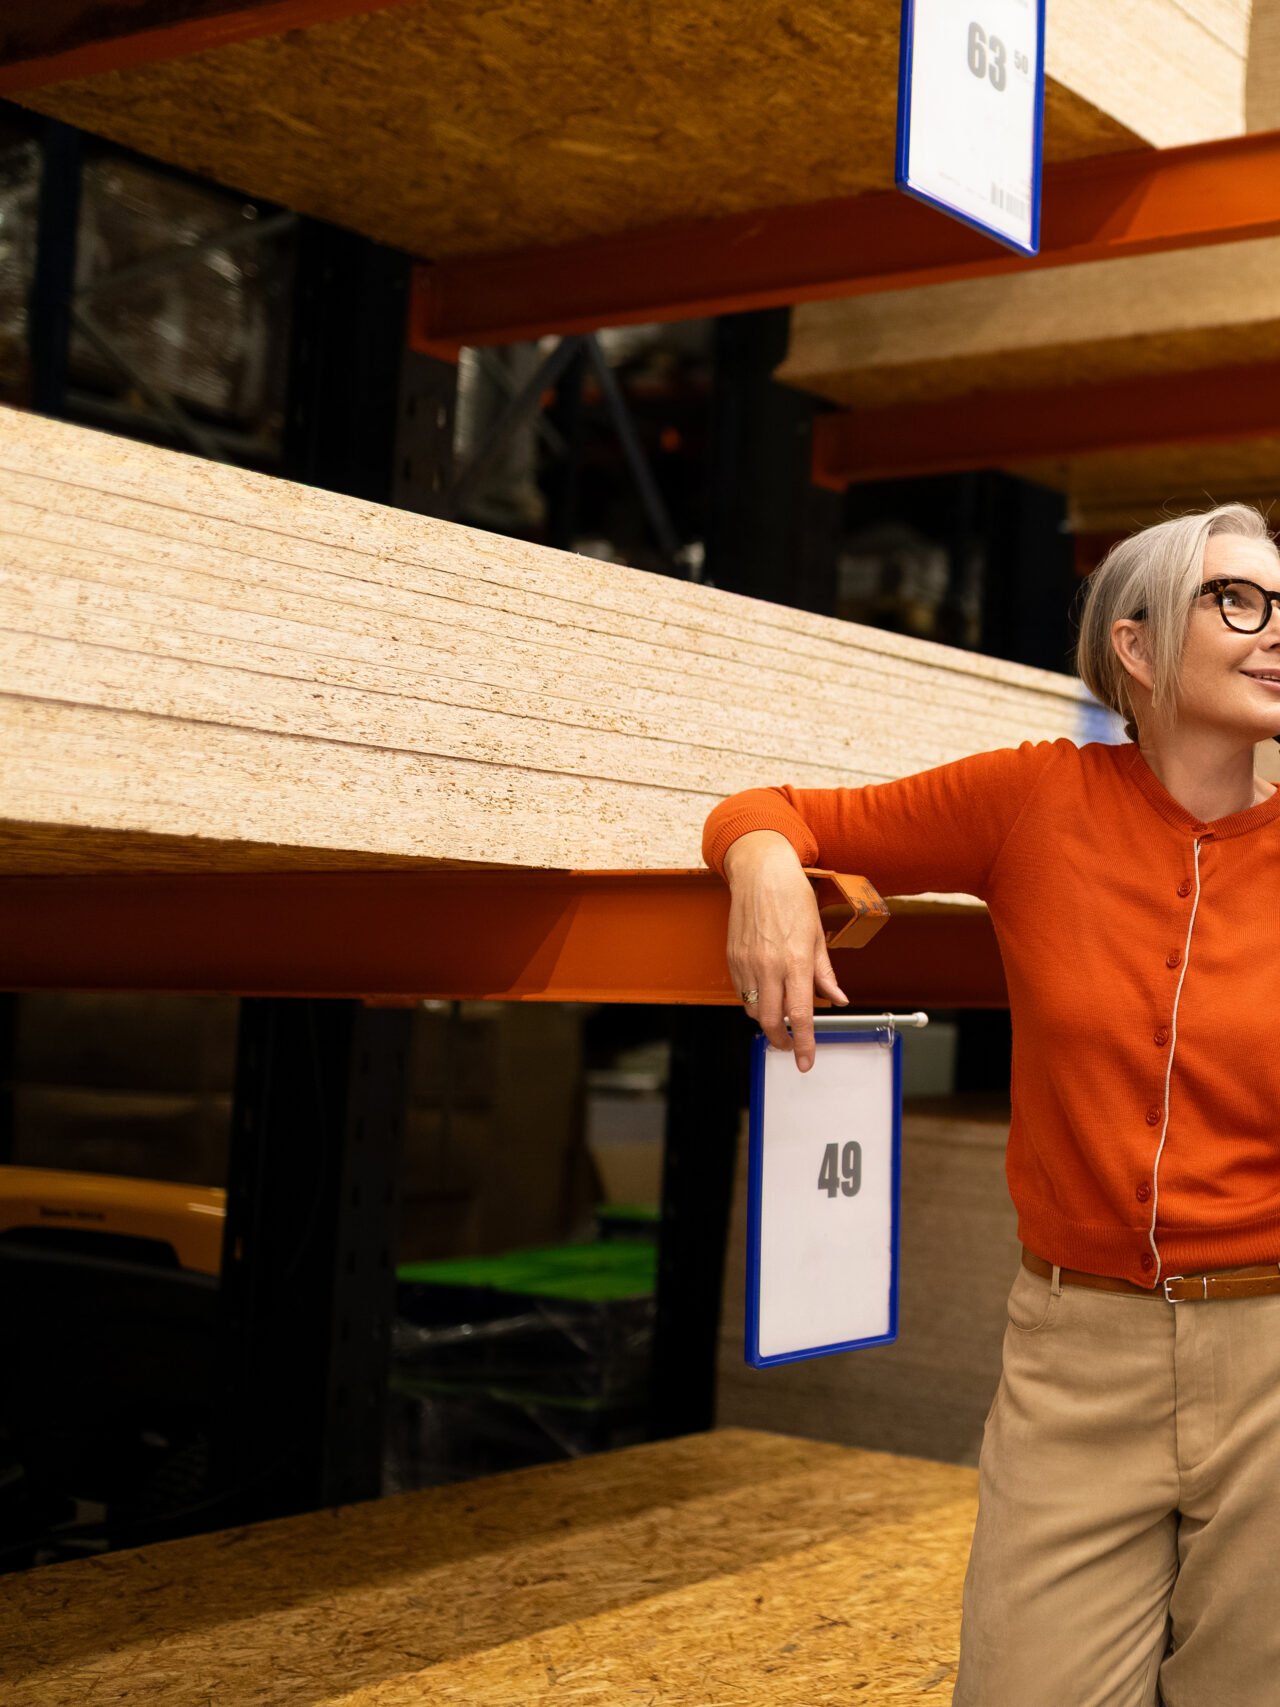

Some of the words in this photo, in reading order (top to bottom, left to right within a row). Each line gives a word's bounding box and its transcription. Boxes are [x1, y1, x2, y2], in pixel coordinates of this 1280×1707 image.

[967, 22, 1006, 92] 63
[1014, 49, 1028, 75] 50
[818, 1141, 861, 1198] 49
